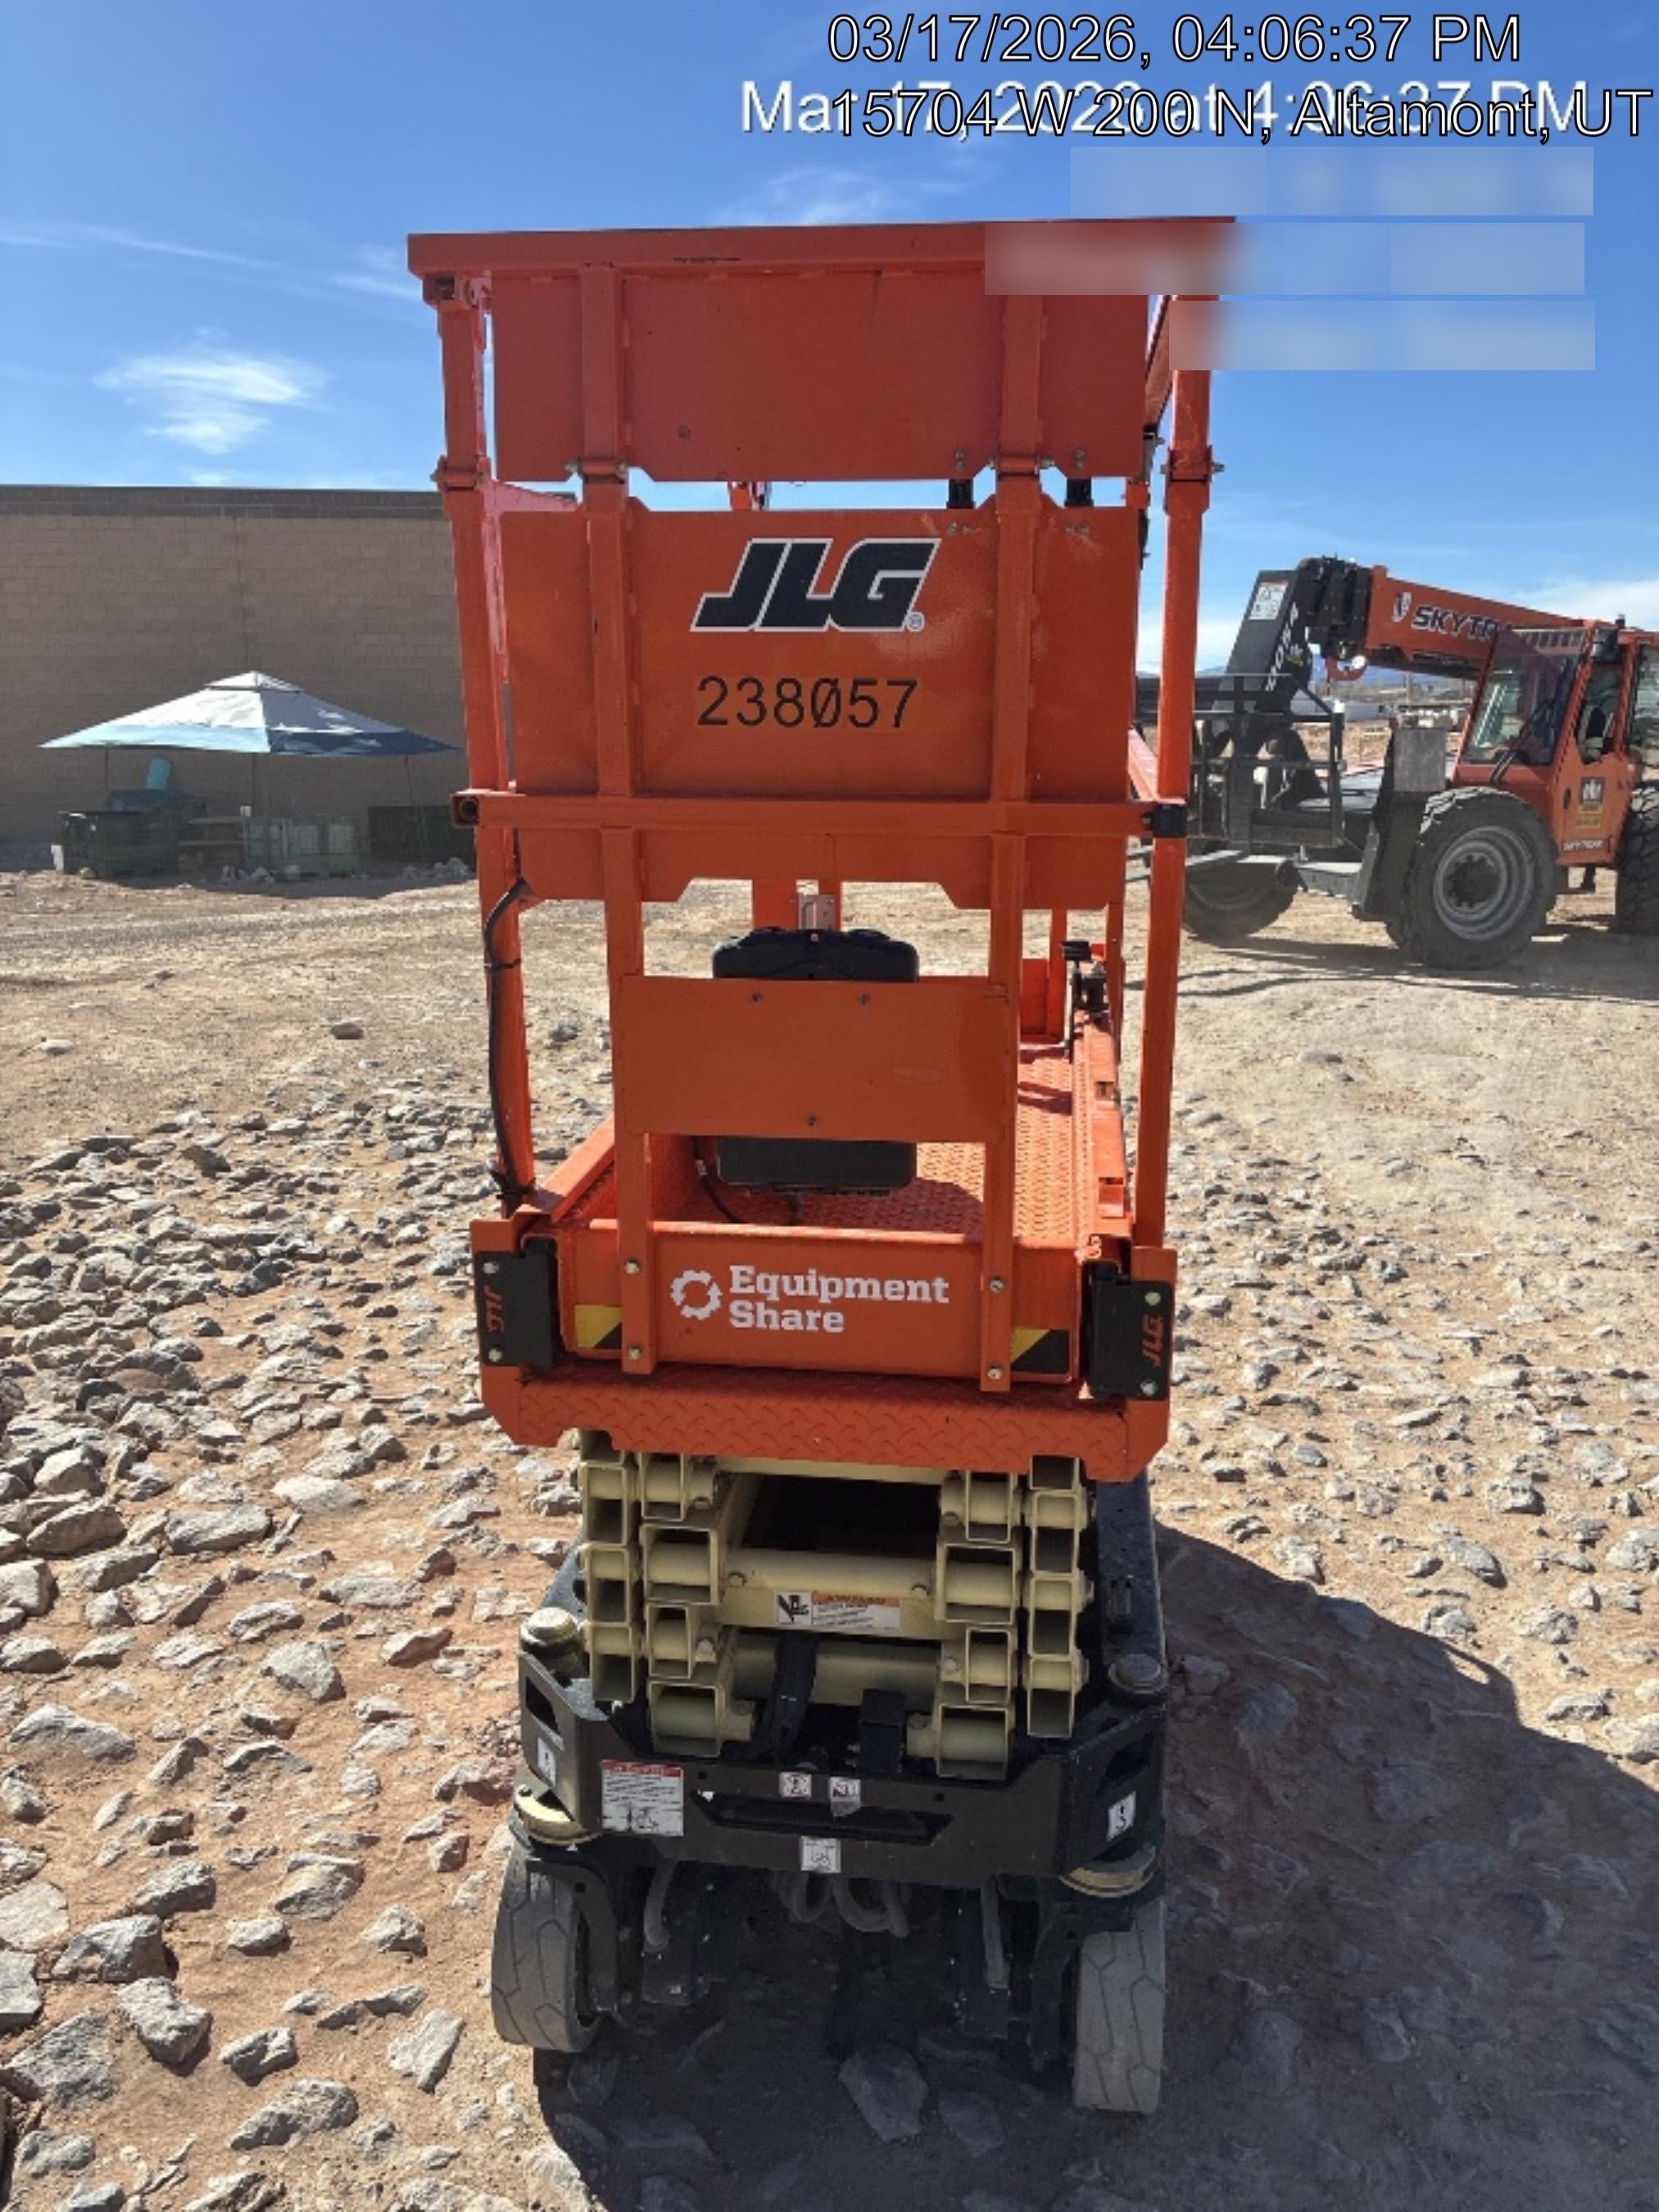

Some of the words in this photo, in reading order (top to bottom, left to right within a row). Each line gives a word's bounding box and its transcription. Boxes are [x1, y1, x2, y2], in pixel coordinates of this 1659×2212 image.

[690, 538, 941, 632] JLG
[1411, 605, 1499, 641] SKYTR
[697, 675, 918, 728] 238057
[729, 1265, 950, 1304] Equipment
[483, 1285, 504, 1334] JLG
[729, 1300, 845, 1333] Share
[1143, 1314, 1163, 1367] JLG
